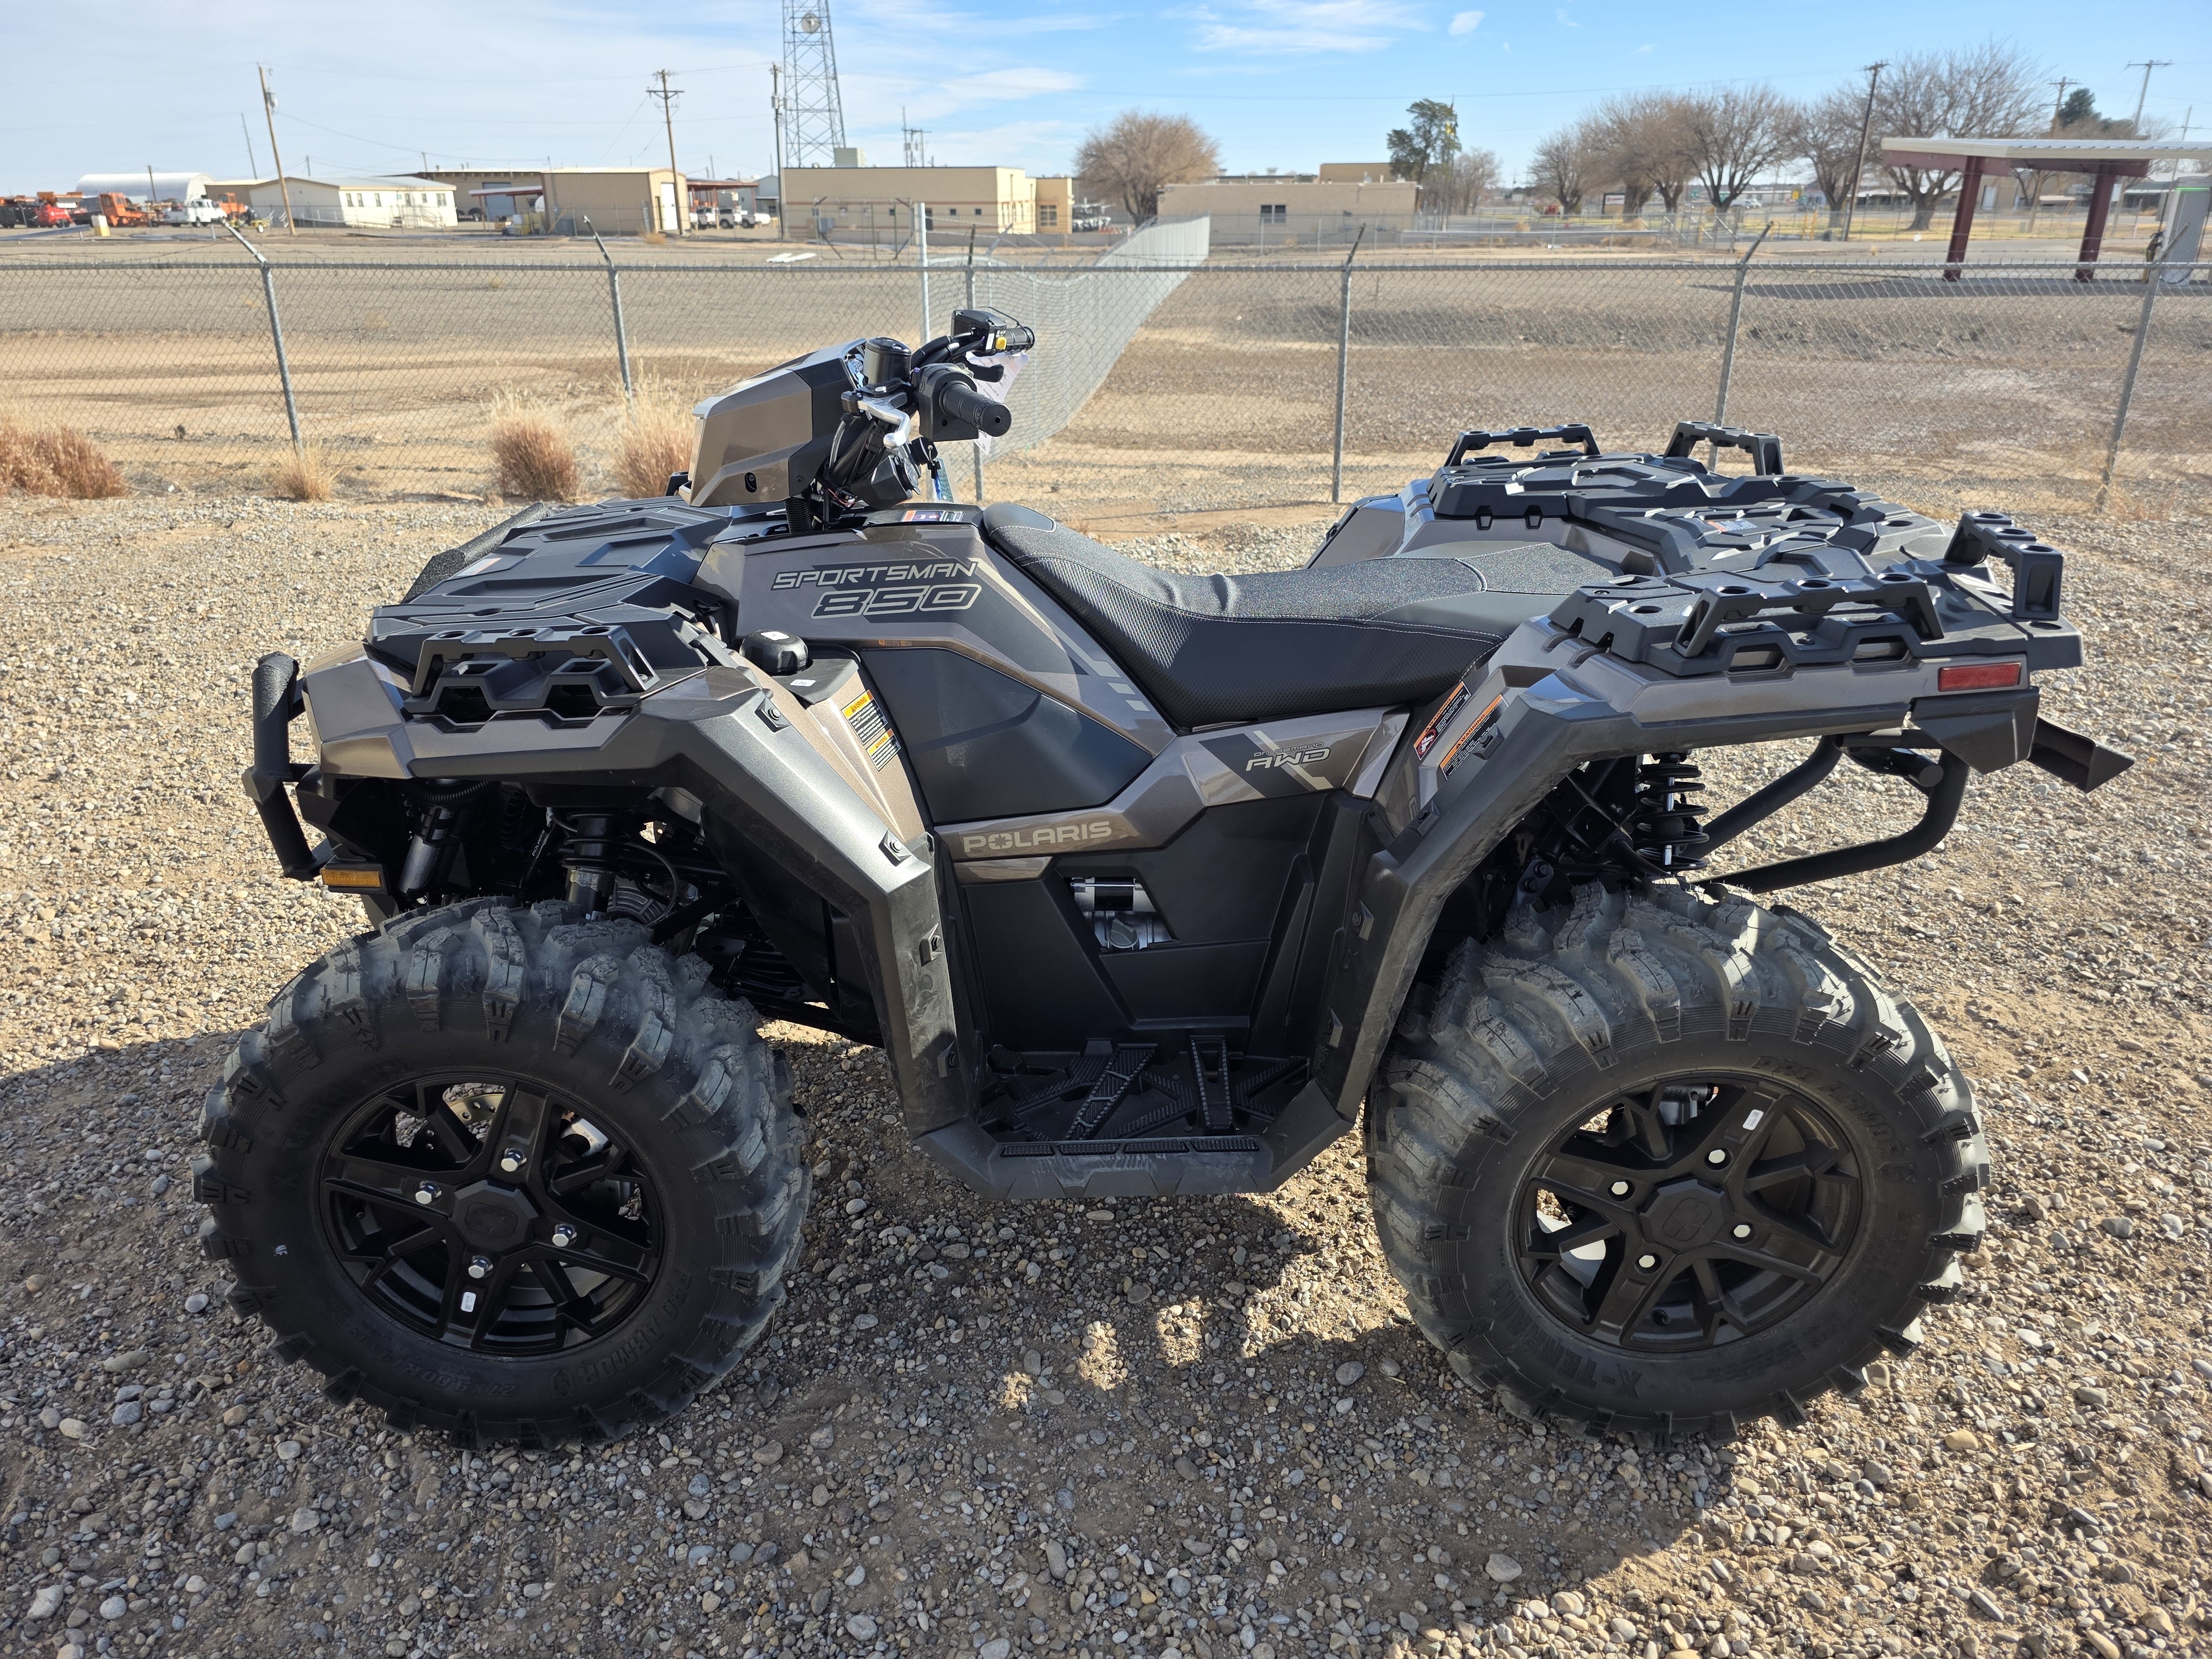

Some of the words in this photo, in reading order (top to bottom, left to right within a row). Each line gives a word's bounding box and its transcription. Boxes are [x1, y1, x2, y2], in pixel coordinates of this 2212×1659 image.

[773, 562, 977, 589] SPORTSMAN
[811, 583, 982, 619] 850
[1429, 699, 1451, 726] WARNING
[1460, 714, 1485, 742] WARNING
[1245, 747, 1331, 771] AWD
[1275, 743, 1323, 754] DEMAND
[531, 830, 545, 857] POLARIS
[963, 821, 1112, 853] POLARIS
[662, 1268, 692, 1322] PRO
[578, 1316, 664, 1385] ARMOR
[1489, 1279, 1643, 1399] X-TERRAIN
